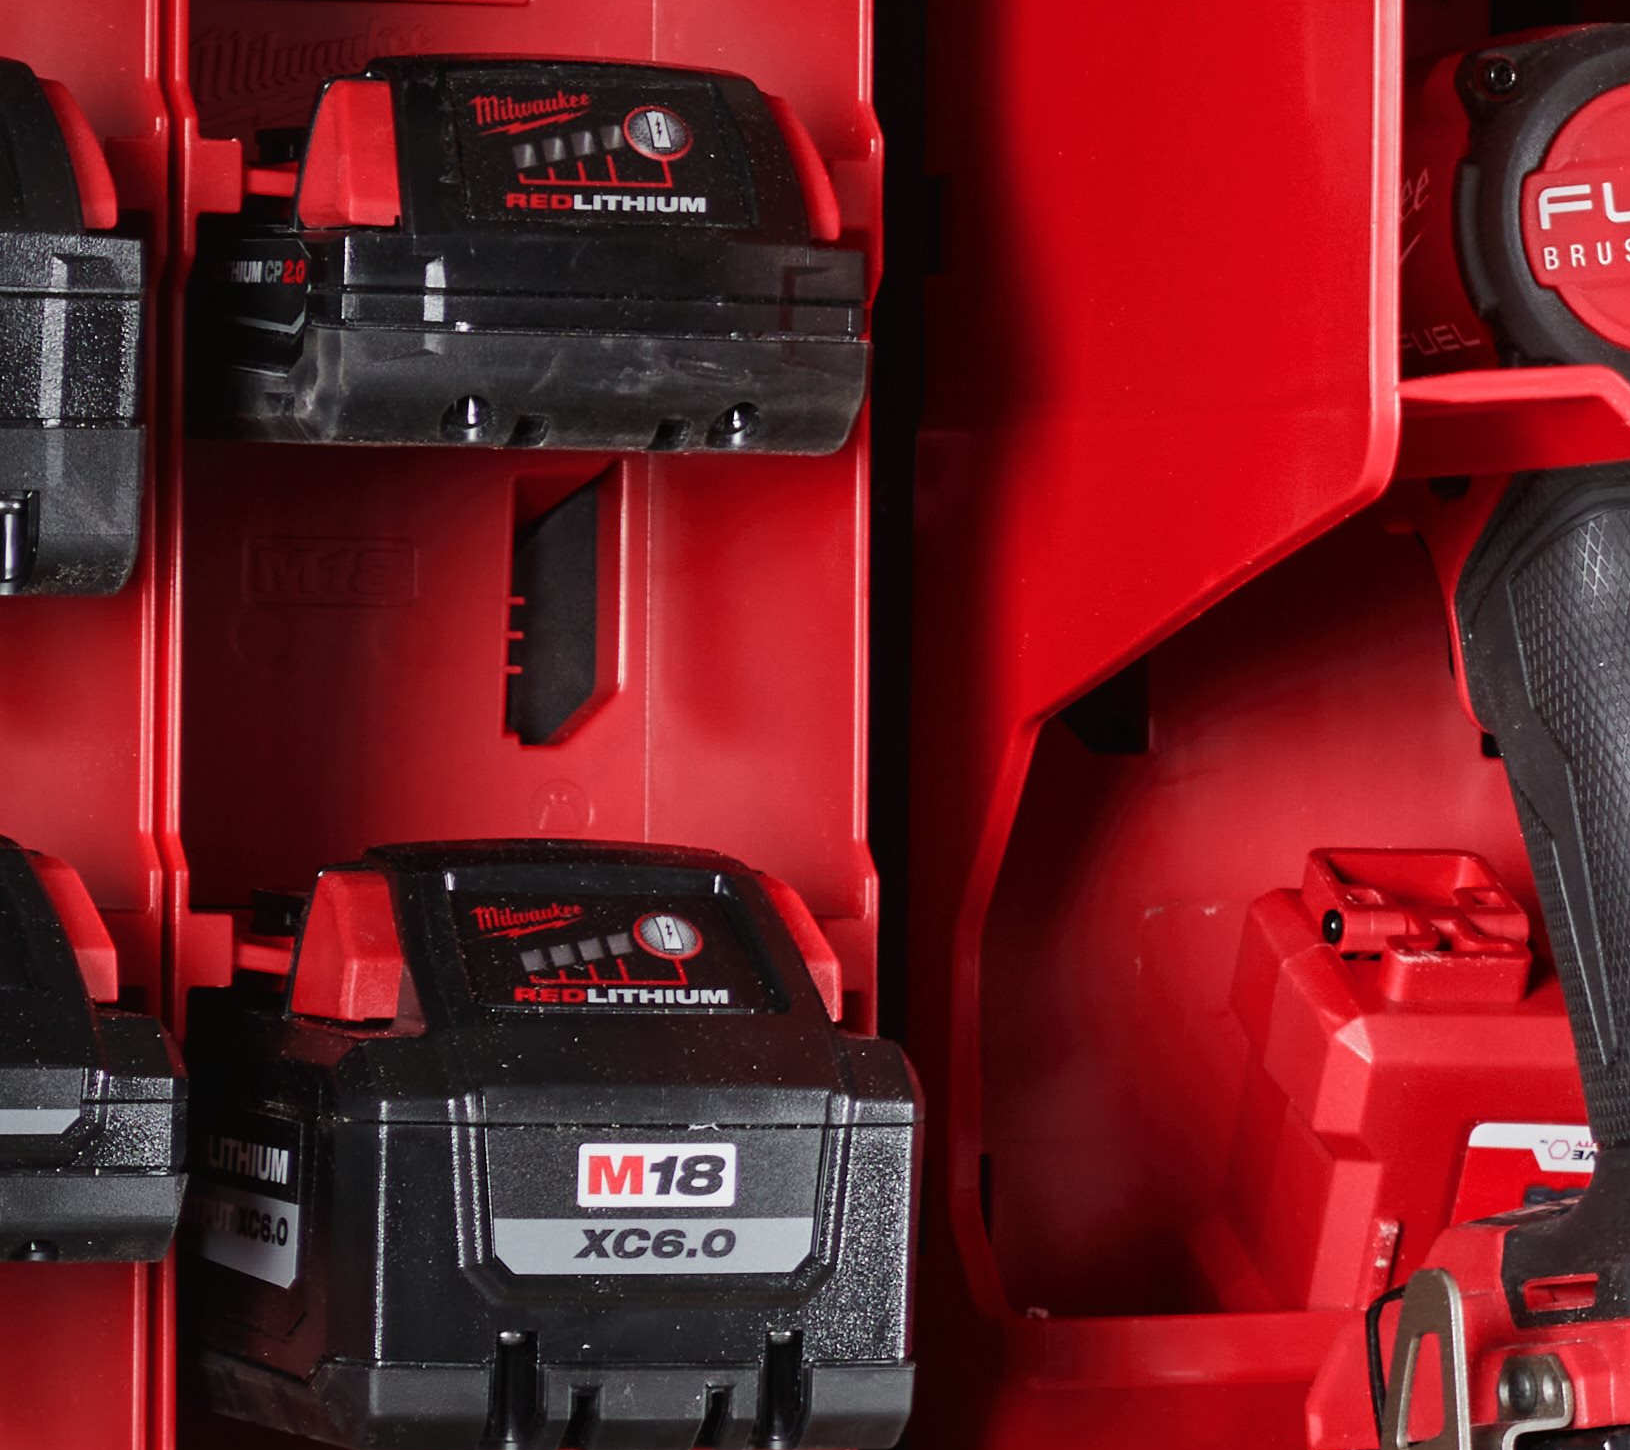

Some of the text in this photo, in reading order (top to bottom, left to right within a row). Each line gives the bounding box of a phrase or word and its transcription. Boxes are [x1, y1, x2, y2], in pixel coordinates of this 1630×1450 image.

[467, 90, 593, 126] Milwaukee
[505, 192, 707, 213] REDLITHIUM
[469, 902, 584, 931] Milwaukee
[513, 987, 729, 1005] REDLITHIUM
[588, 1154, 727, 1197] M18
[573, 1227, 737, 1259] XC6.0
